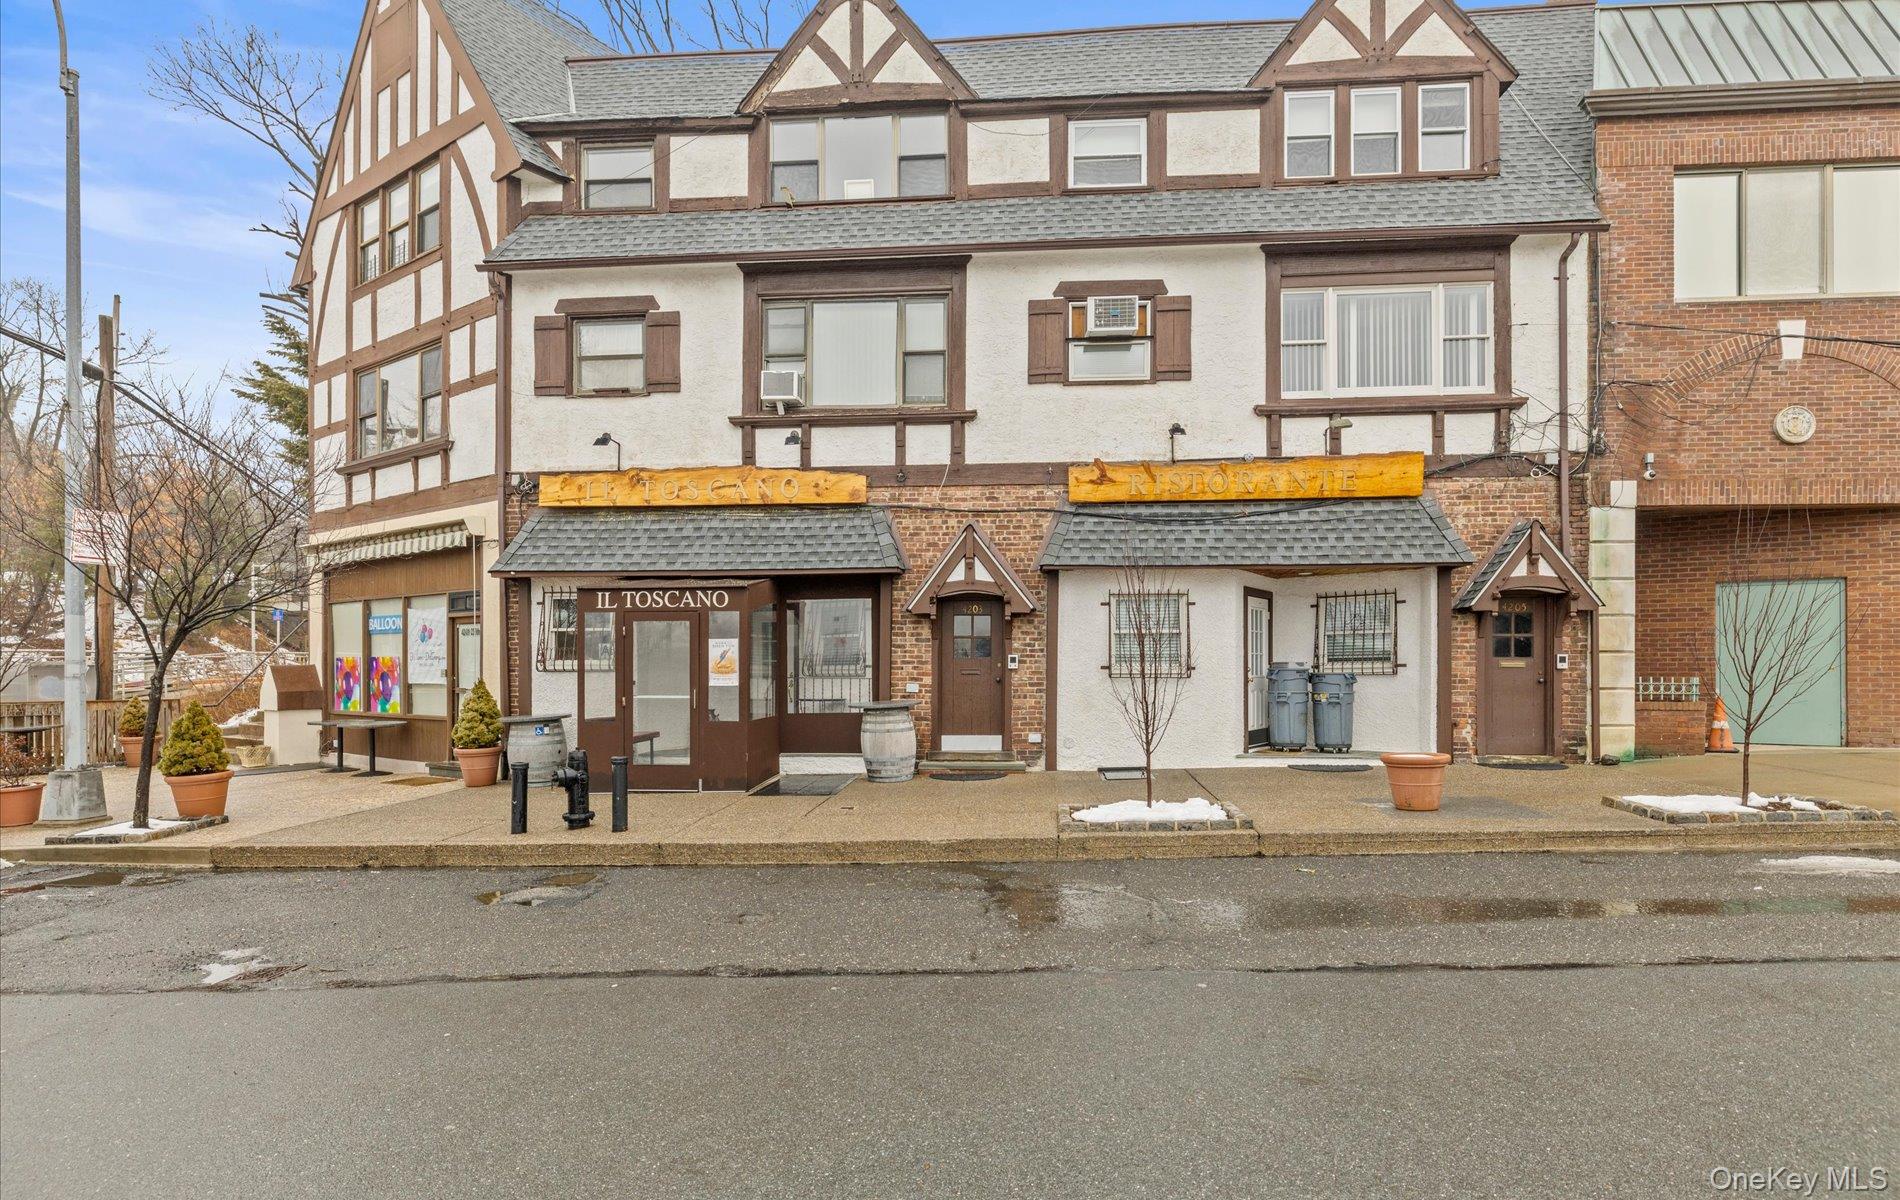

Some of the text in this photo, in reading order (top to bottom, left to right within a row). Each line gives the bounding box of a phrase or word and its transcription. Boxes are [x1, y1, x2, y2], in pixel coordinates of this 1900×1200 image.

[585, 477, 801, 500] IL TOSCANO
[1128, 468, 1358, 496] RISTORANTE
[595, 590, 729, 609] IL TOSCANO
[368, 617, 403, 631] BALLOON
